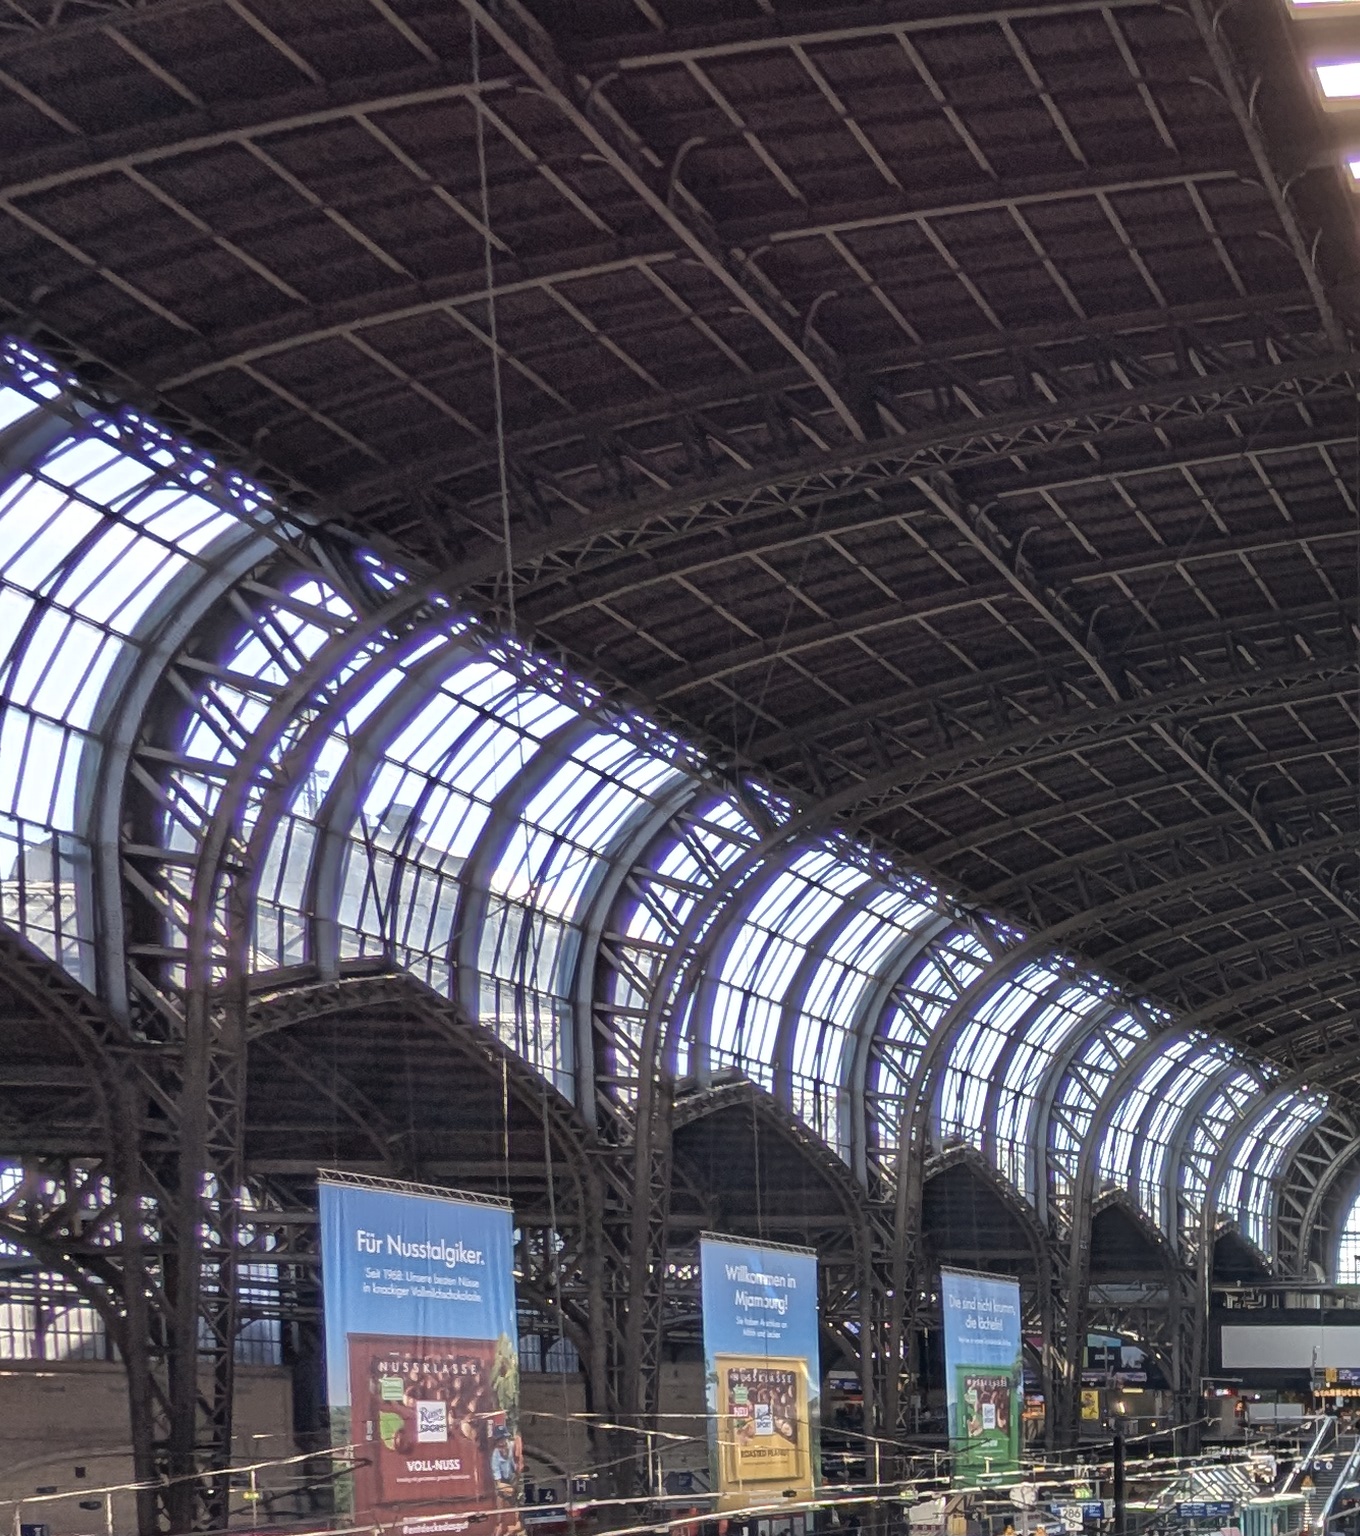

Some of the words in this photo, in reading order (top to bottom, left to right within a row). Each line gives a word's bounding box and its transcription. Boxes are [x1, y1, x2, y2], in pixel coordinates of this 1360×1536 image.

[356, 1229, 383, 1254] Für
[387, 1235, 485, 1268] Nusstalgiker.
[725, 1264, 786, 1288] Willkommen
[787, 1273, 796, 1289] in
[949, 1294, 962, 1309] Die
[962, 1297, 976, 1312] sind
[977, 1298, 992, 1312] nicht
[965, 1315, 977, 1329] die
[379, 1362, 478, 1375] NUSSKLASSE
[406, 1459, 460, 1472] VOLL-NUSS
[576, 1480, 587, 1492] H
[545, 1490, 553, 1501] 4
[1062, 1508, 1082, 1519] 286
